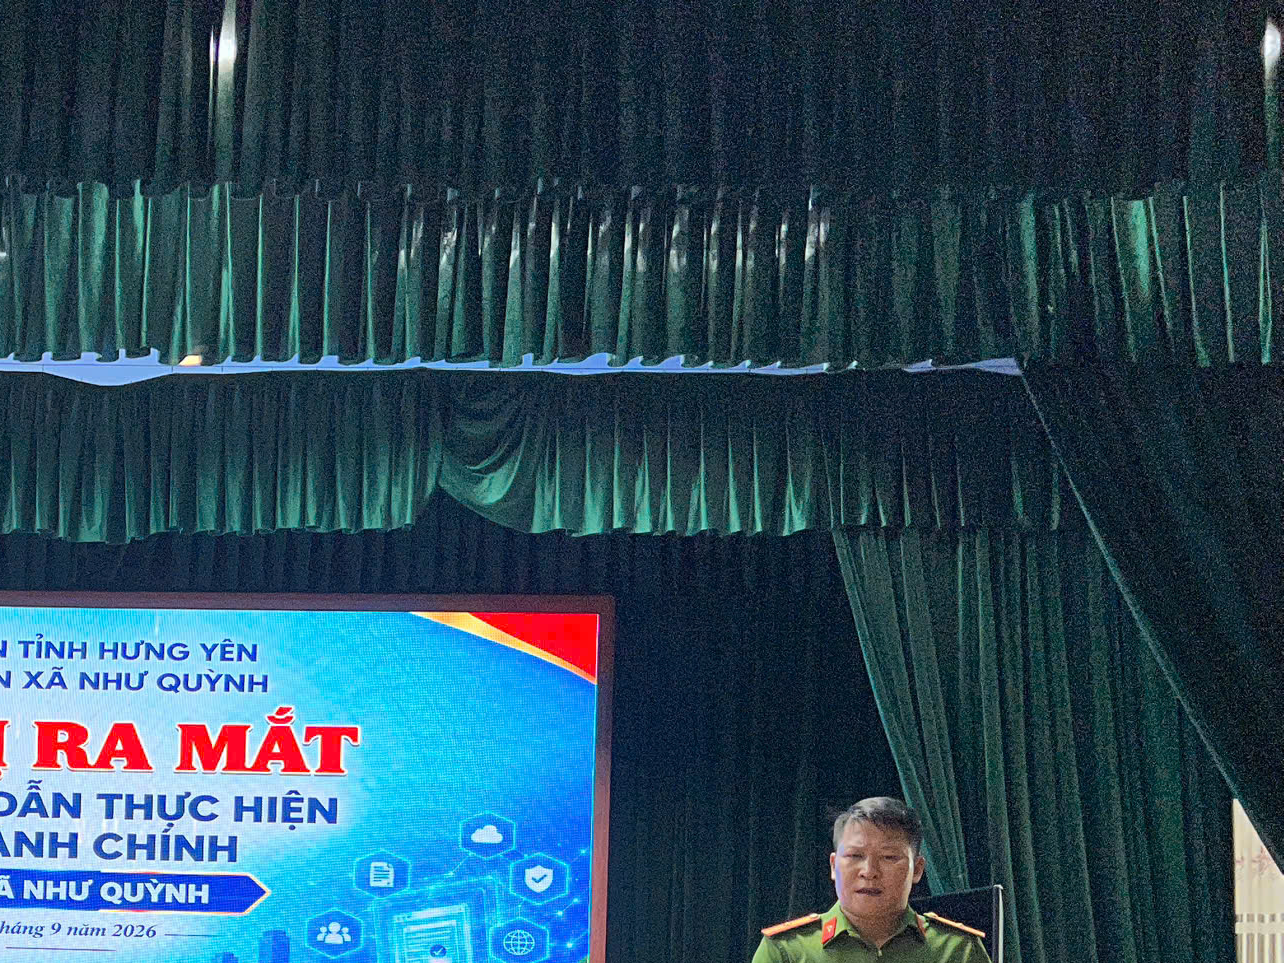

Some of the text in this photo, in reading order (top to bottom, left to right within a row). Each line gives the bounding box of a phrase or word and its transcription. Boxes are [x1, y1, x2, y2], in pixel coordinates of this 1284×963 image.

[18, 633, 87, 659] TỈNH
[98, 640, 190, 661] HƯNG
[199, 638, 258, 662] YÊN
[22, 666, 68, 690] XÃ
[79, 671, 149, 691] NHƯ
[156, 668, 268, 693] QUỲNH
[31, 720, 154, 772] RA
[174, 706, 360, 775] MẮT
[96, 791, 219, 827] THỰC
[234, 790, 338, 831] HIỆN
[93, 824, 238, 862] CHÍNH
[23, 879, 93, 900] NHƯ
[100, 878, 209, 905] QUỲNH
[51, 922, 61, 935] 9
[67, 923, 106, 937] năm
[112, 924, 157, 938] 2026
